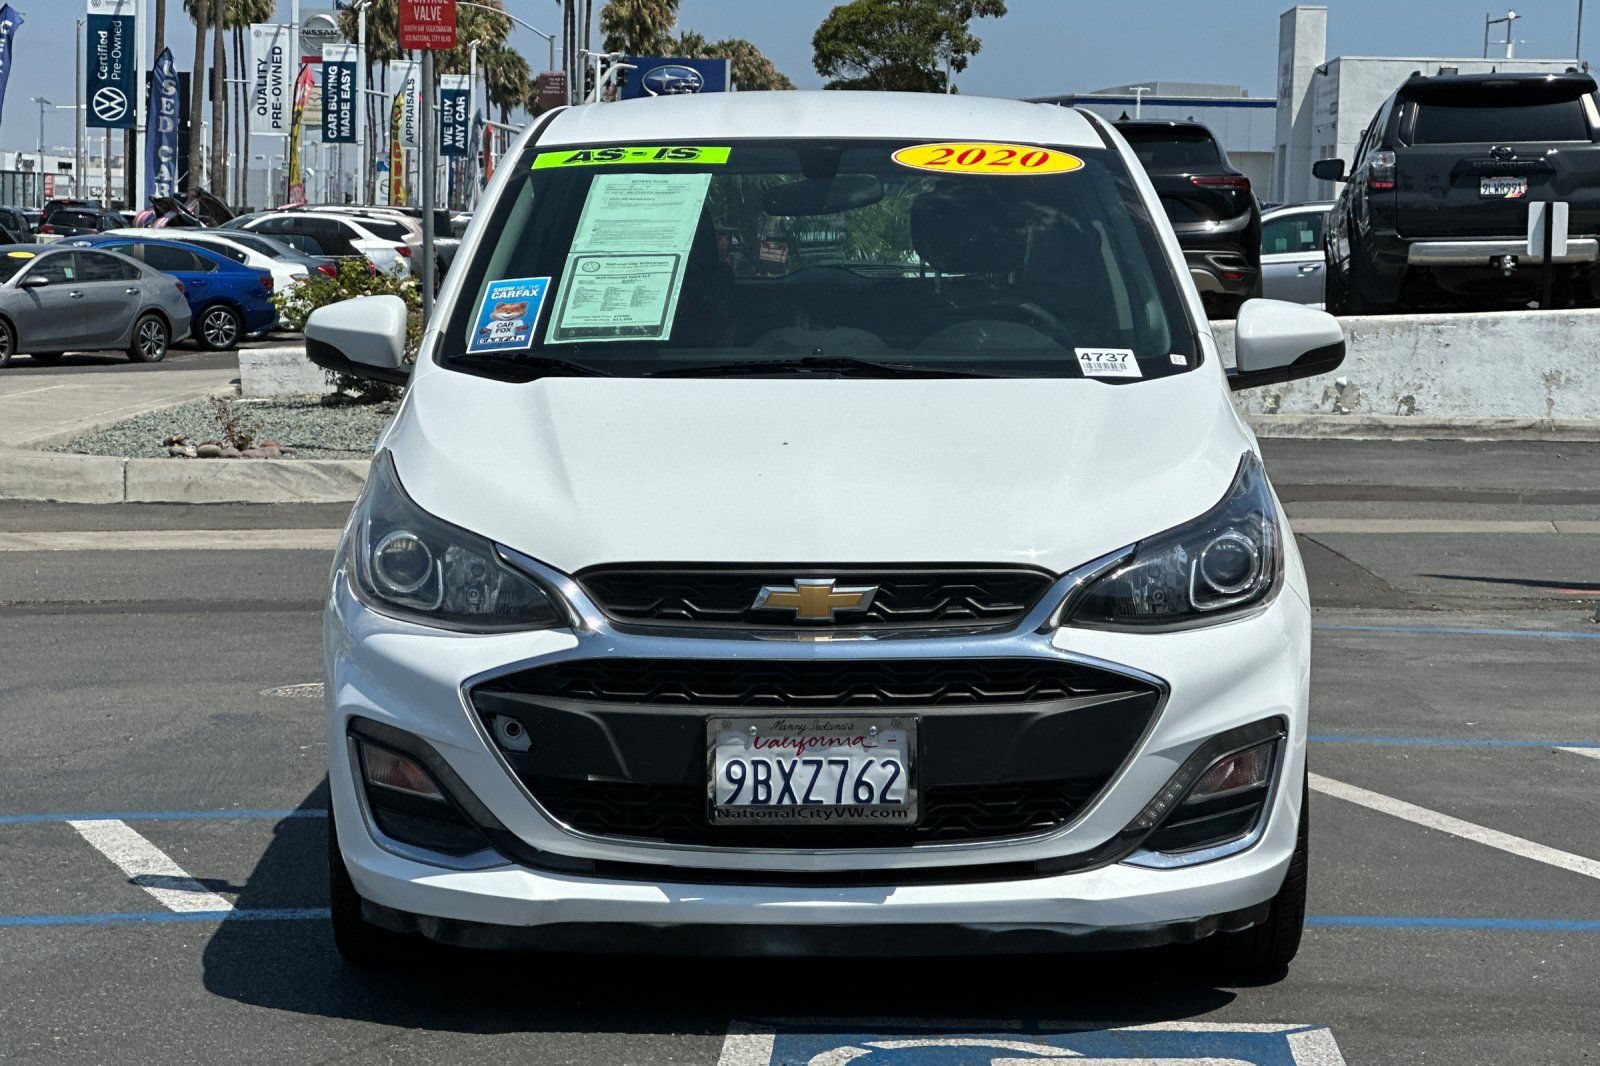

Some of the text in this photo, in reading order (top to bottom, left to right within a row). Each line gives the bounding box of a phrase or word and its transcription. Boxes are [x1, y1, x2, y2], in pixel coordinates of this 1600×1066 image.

[413, 5, 442, 21] VALVE
[302, 28, 338, 37] NISSAN
[97, 30, 108, 80] Certified
[111, 20, 122, 80] Pre-Owned
[257, 58, 268, 116] QUALITY
[271, 46, 282, 129] PRE-OWNED
[327, 65, 338, 139] CAR BUYING
[340, 68, 351, 137] MADE EASY
[405, 78, 415, 144] APPRAISALS
[455, 95, 466, 121] CAR
[443, 98, 454, 146] WE BUY
[455, 125, 465, 149] ANY
[924, 147, 1050, 168] 2020
[491, 288, 540, 300] CARFAX
[1080, 352, 1129, 363] 4737
[770, 719, 808, 736] Manny
[753, 735, 879, 757] California
[724, 758, 903, 805] 9BXZ7762
[716, 807, 908, 821] NationalCityVW.com
